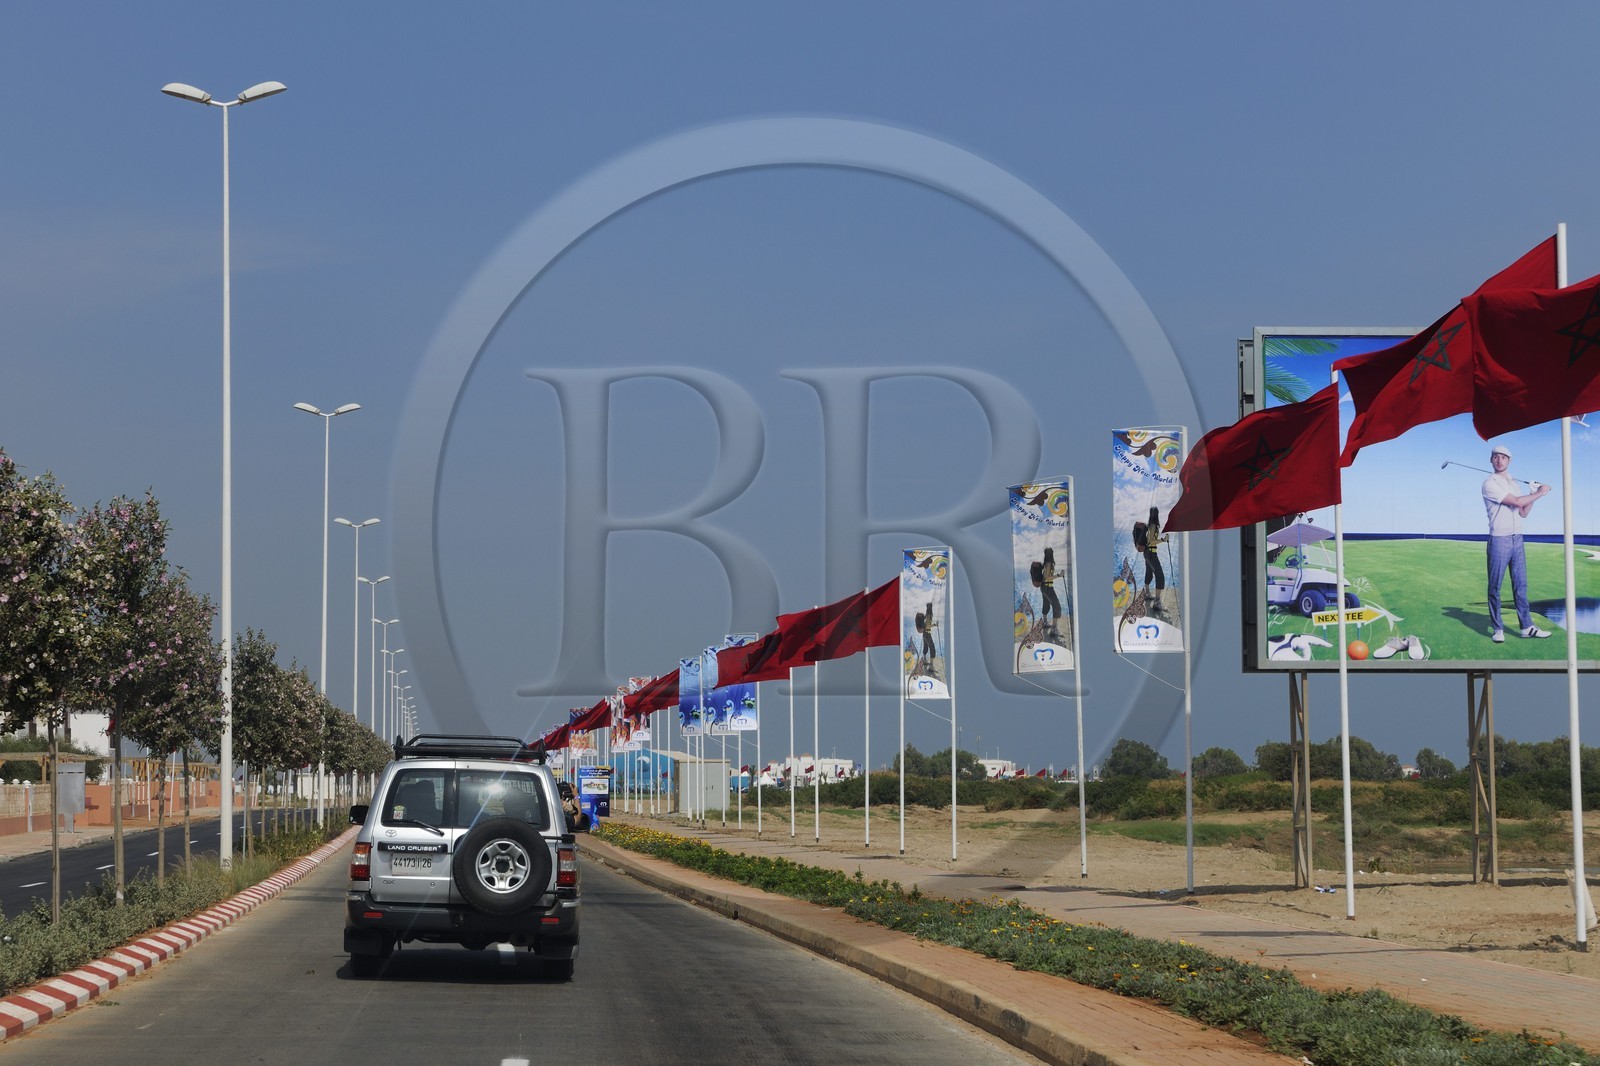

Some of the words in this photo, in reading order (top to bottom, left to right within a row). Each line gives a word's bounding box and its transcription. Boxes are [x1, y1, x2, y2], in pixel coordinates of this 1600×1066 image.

[1114, 445, 1133, 467] Happy
[1133, 465, 1150, 477] New
[1010, 497, 1028, 516] Happy
[1028, 513, 1043, 523] New
[1317, 614, 1339, 622] NEX
[1345, 612, 1363, 620] TEE
[393, 857, 416, 868] 44173
[422, 858, 432, 868] 26
